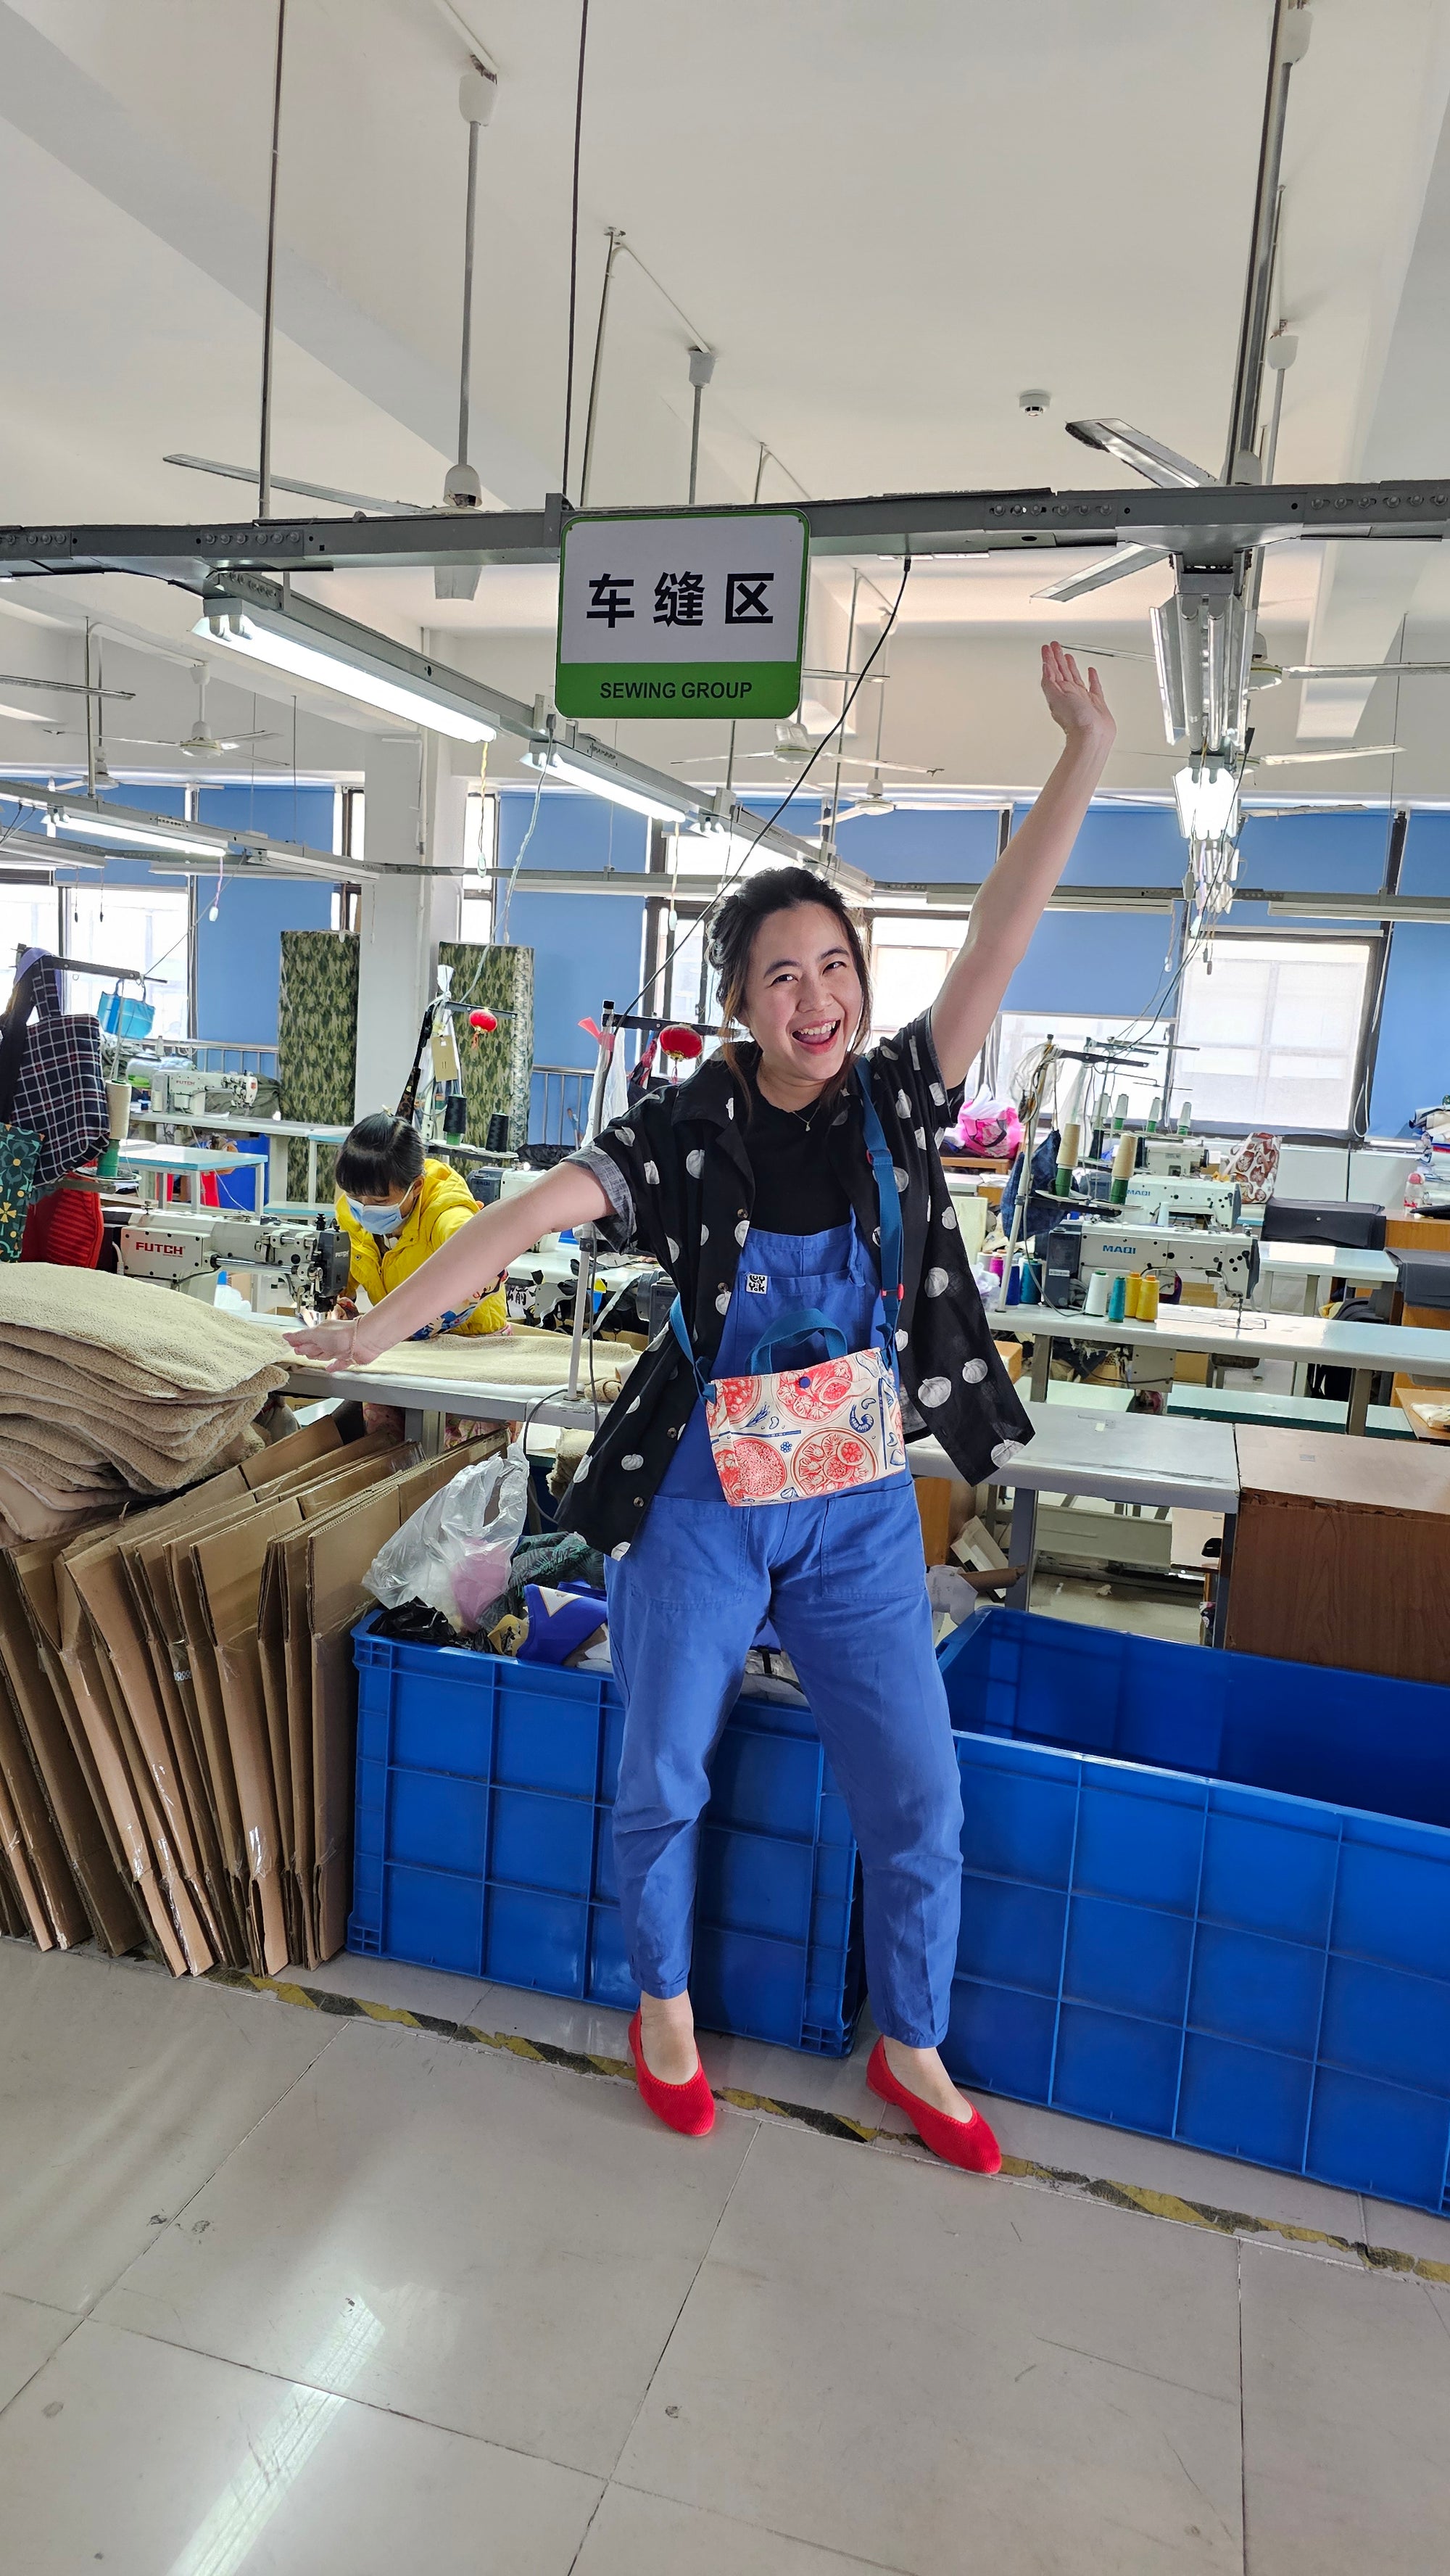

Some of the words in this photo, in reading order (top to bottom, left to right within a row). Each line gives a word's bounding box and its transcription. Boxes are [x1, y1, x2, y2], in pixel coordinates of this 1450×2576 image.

[586, 571, 775, 629] 车缝区
[600, 682, 676, 699] SEWING
[682, 682, 753, 699] GROUP
[136, 1242, 183, 1255] FUTCH
[1102, 1244, 1137, 1255] MAQI
